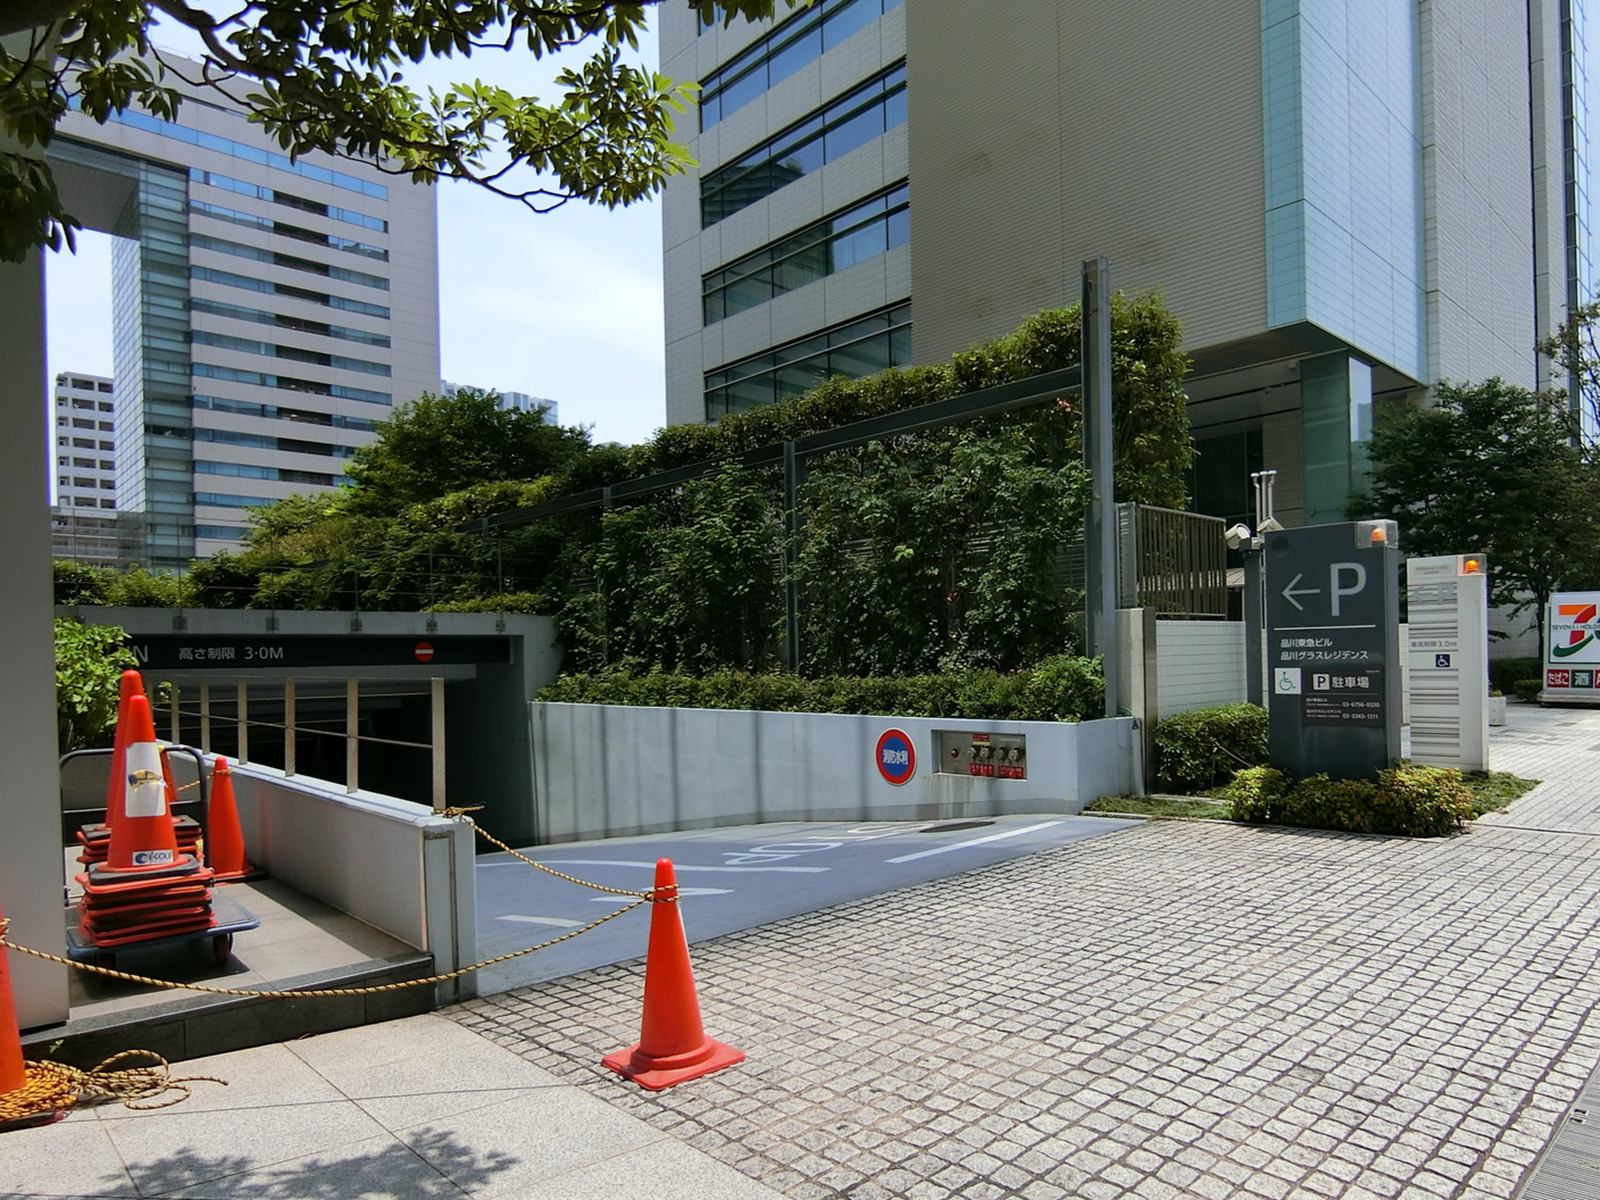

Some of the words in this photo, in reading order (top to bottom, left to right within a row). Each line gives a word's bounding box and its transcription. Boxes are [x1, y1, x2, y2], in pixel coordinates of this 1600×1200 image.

[1330, 562, 1366, 616] P
[1280, 638, 1333, 648] 品川東急ビル
[179, 647, 235, 660] 高さ制限
[1280, 650, 1369, 661] 品川グラスレジデンス
[1332, 676, 1370, 689] 駐車場
[1548, 672, 1569, 685] たばこ
[1574, 672, 1590, 686] 酒
